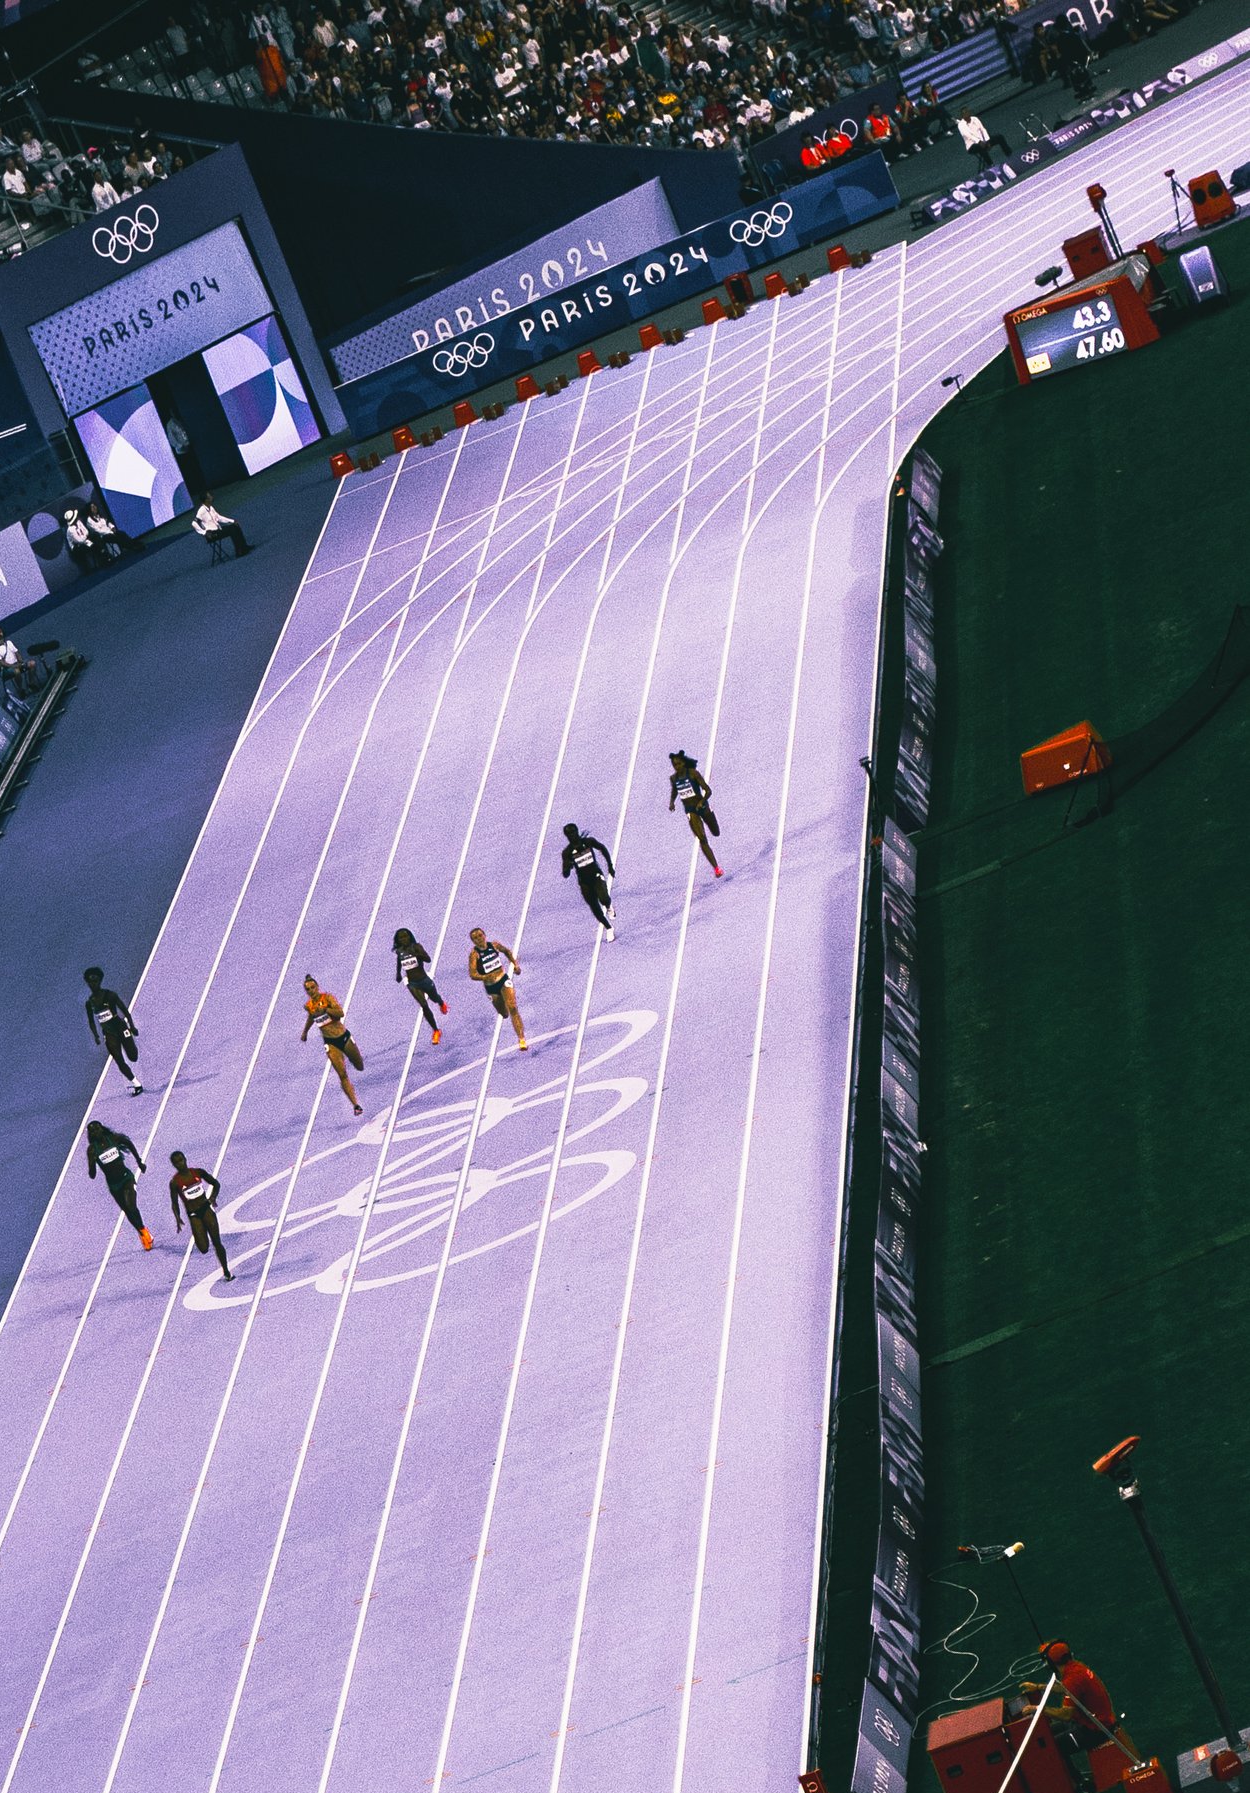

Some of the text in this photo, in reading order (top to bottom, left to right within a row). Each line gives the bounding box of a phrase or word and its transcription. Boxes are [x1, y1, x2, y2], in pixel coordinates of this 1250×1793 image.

[518, 239, 609, 302] 2024
[622, 246, 708, 297] 2024
[157, 275, 220, 320] 2024
[1020, 307, 1049, 323] OMEGA
[1072, 301, 1112, 330] 43.3
[1076, 327, 1126, 360] 47.60
